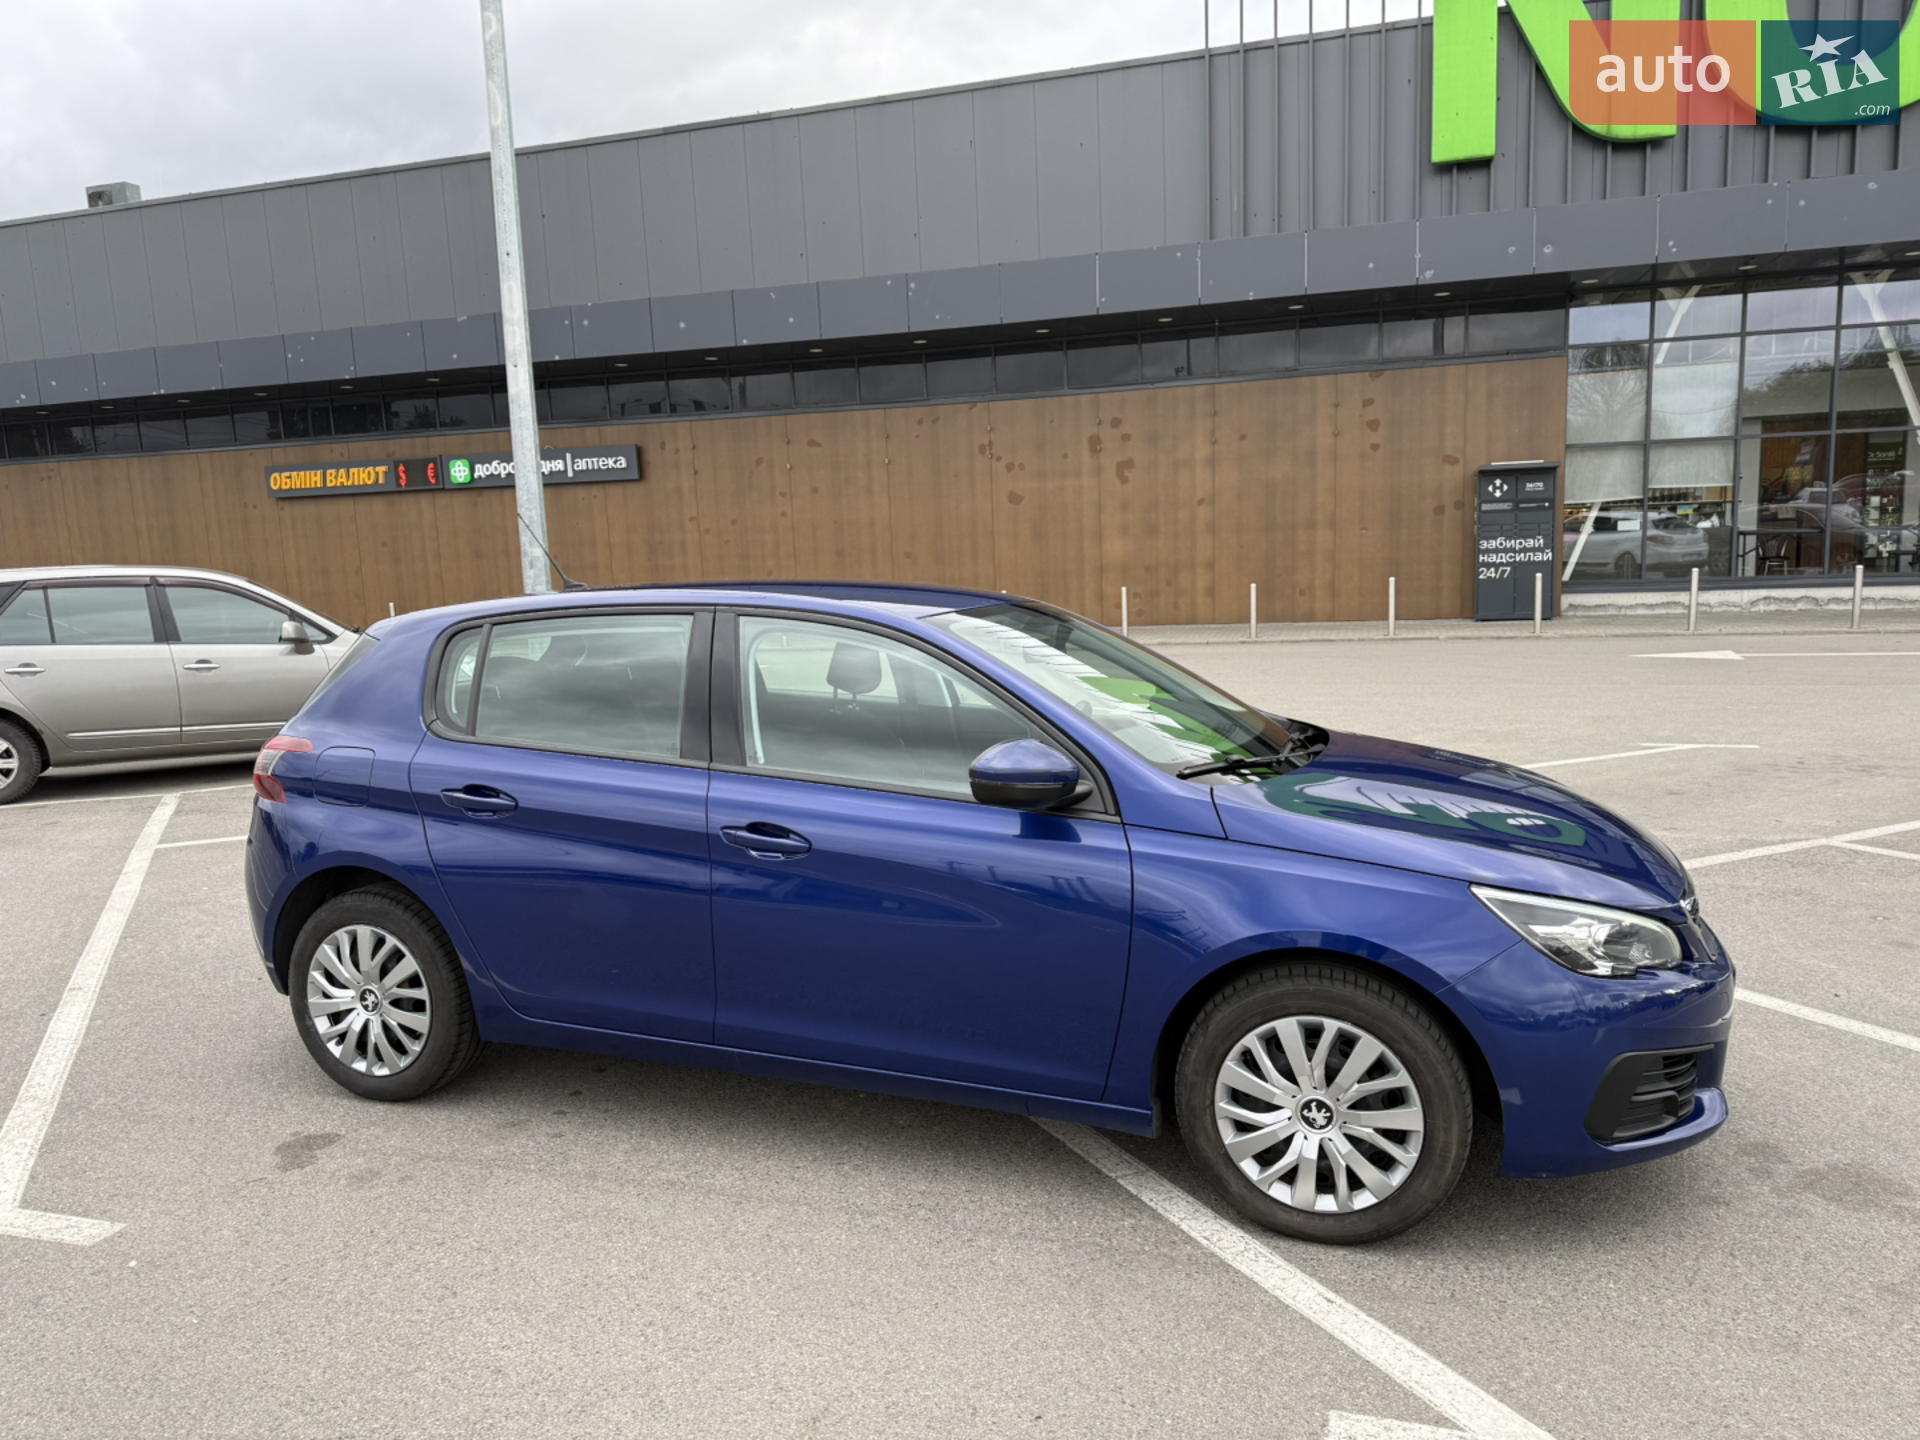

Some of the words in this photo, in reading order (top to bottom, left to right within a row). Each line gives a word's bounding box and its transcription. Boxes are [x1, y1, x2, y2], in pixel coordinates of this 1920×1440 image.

[473, 460, 516, 479] добро
[573, 455, 628, 472] аптека
[270, 469, 323, 491] ОБМІН
[326, 465, 389, 488] ВАЛЮТ
[1478, 535, 1544, 551] забирай
[1478, 549, 1553, 564] надсилай
[1478, 566, 1511, 579] 24/7
